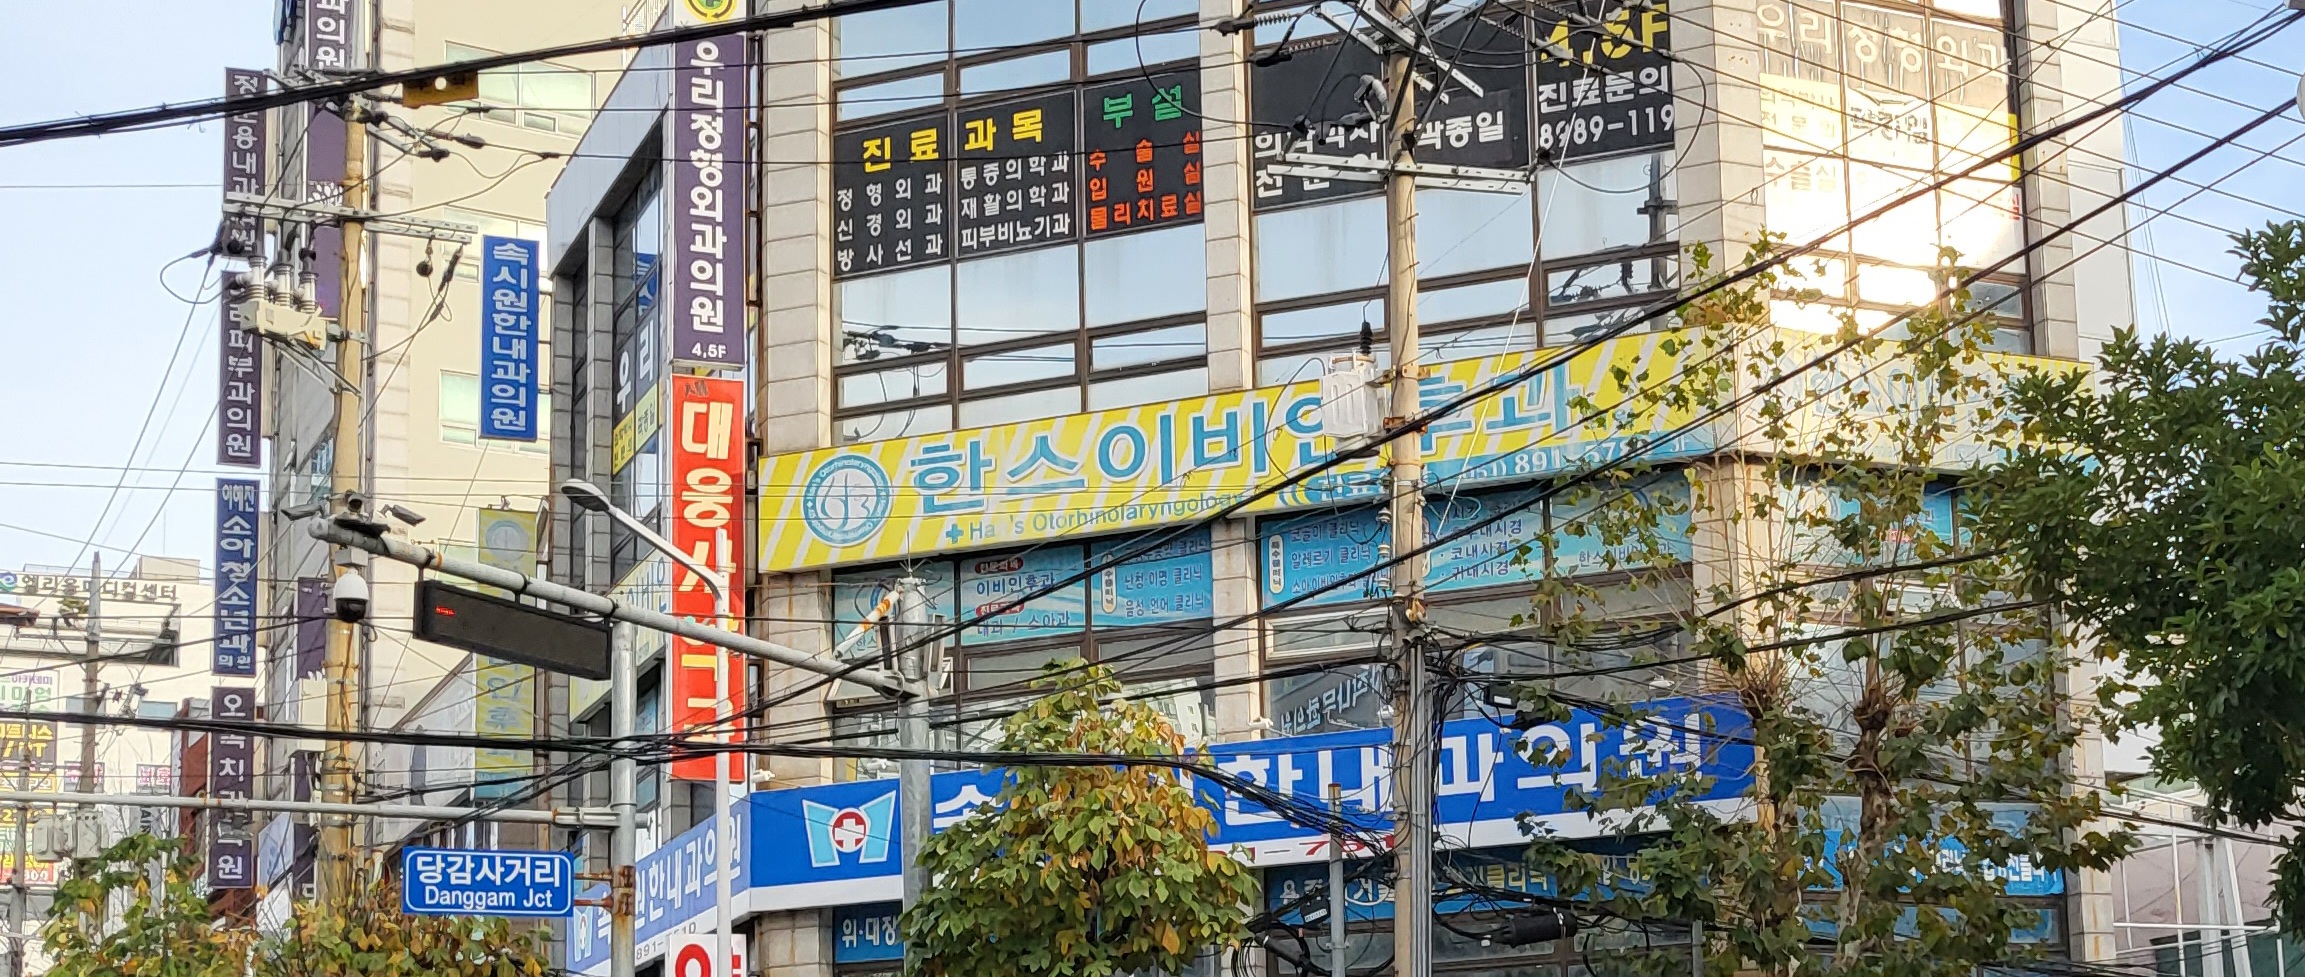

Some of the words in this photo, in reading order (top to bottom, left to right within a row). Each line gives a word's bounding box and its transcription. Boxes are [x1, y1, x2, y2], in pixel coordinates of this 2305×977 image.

[1102, 84, 1183, 129] 부설
[1538, 66, 1669, 113] 진료문의
[1416, 110, 1504, 150] 곽종일
[960, 151, 1070, 188] 통증의학과
[1088, 131, 1201, 171] 수술실
[690, 40, 728, 333] 우리정형외과의원
[837, 172, 943, 213] 정형외과
[960, 181, 1070, 220] 재활의학과
[1088, 160, 1201, 202] 입원실
[837, 202, 943, 243] 신경외과
[1090, 191, 1202, 231] 물리치료실
[961, 213, 1071, 250] 피부비뇨기과
[837, 233, 943, 273] 방사선과
[490, 242, 532, 431] 속시원한내과의원
[1173, 563, 1202, 586] 클리닉
[1291, 548, 1334, 570] 알레르기
[1339, 544, 1372, 564] 클리닉
[975, 571, 1056, 598] 이비인후과
[1174, 592, 1205, 612] 클리닉
[931, 711, 1705, 840] 속한내과의원
[416, 854, 561, 889] 당감사거리
[597, 813, 741, 946] 속원한내과의원
[424, 886, 516, 909] Danggam
[523, 885, 553, 908] Jct
